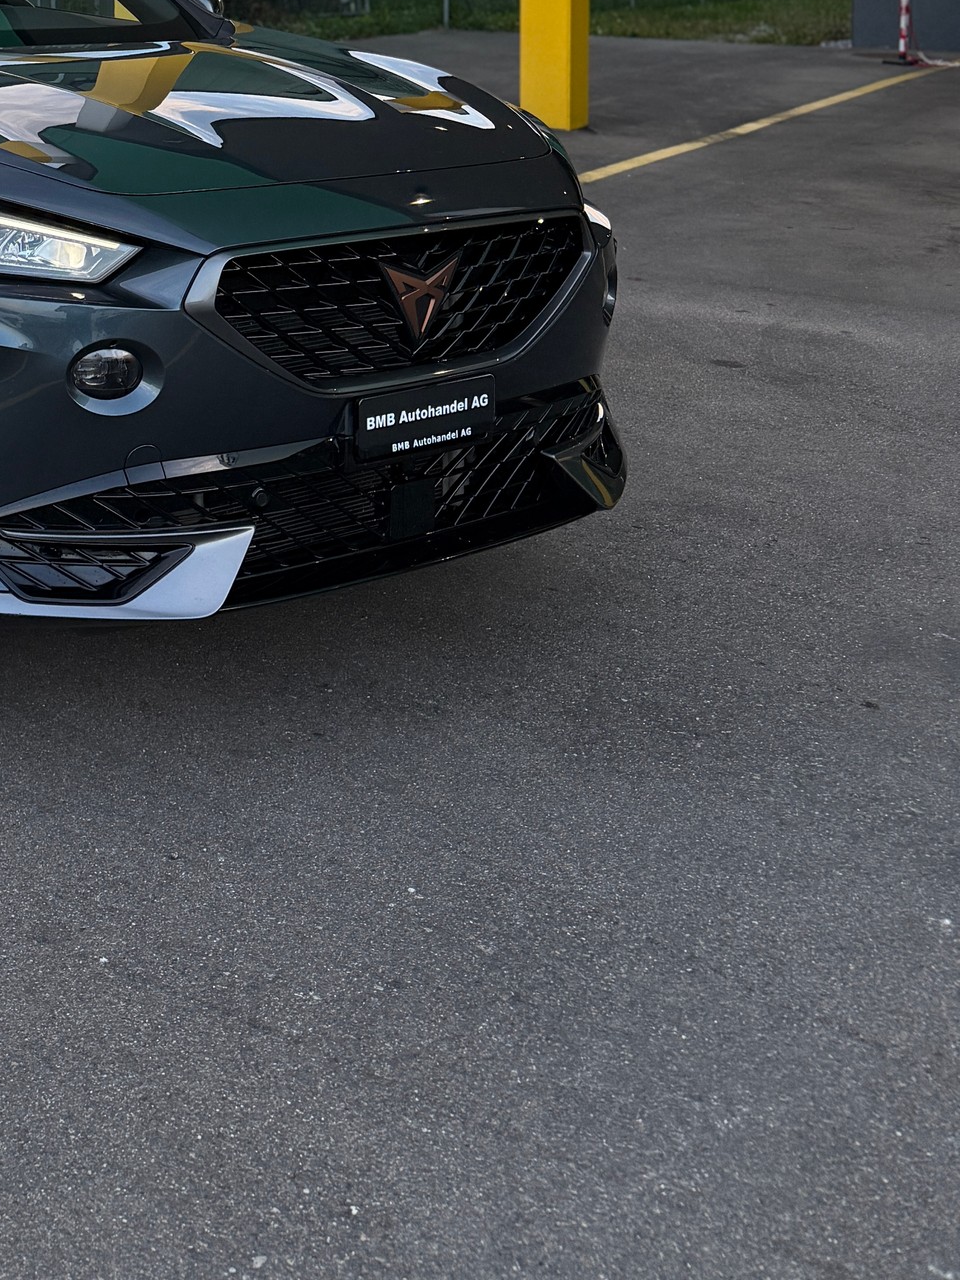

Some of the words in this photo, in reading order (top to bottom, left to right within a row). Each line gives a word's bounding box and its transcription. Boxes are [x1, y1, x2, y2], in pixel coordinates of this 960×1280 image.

[366, 412, 396, 431] BMB
[399, 397, 468, 424] Autohandel
[471, 393, 489, 409] AG
[391, 440, 410, 453] BMB
[413, 430, 459, 448] Autohandel
[460, 427, 472, 438] AG
